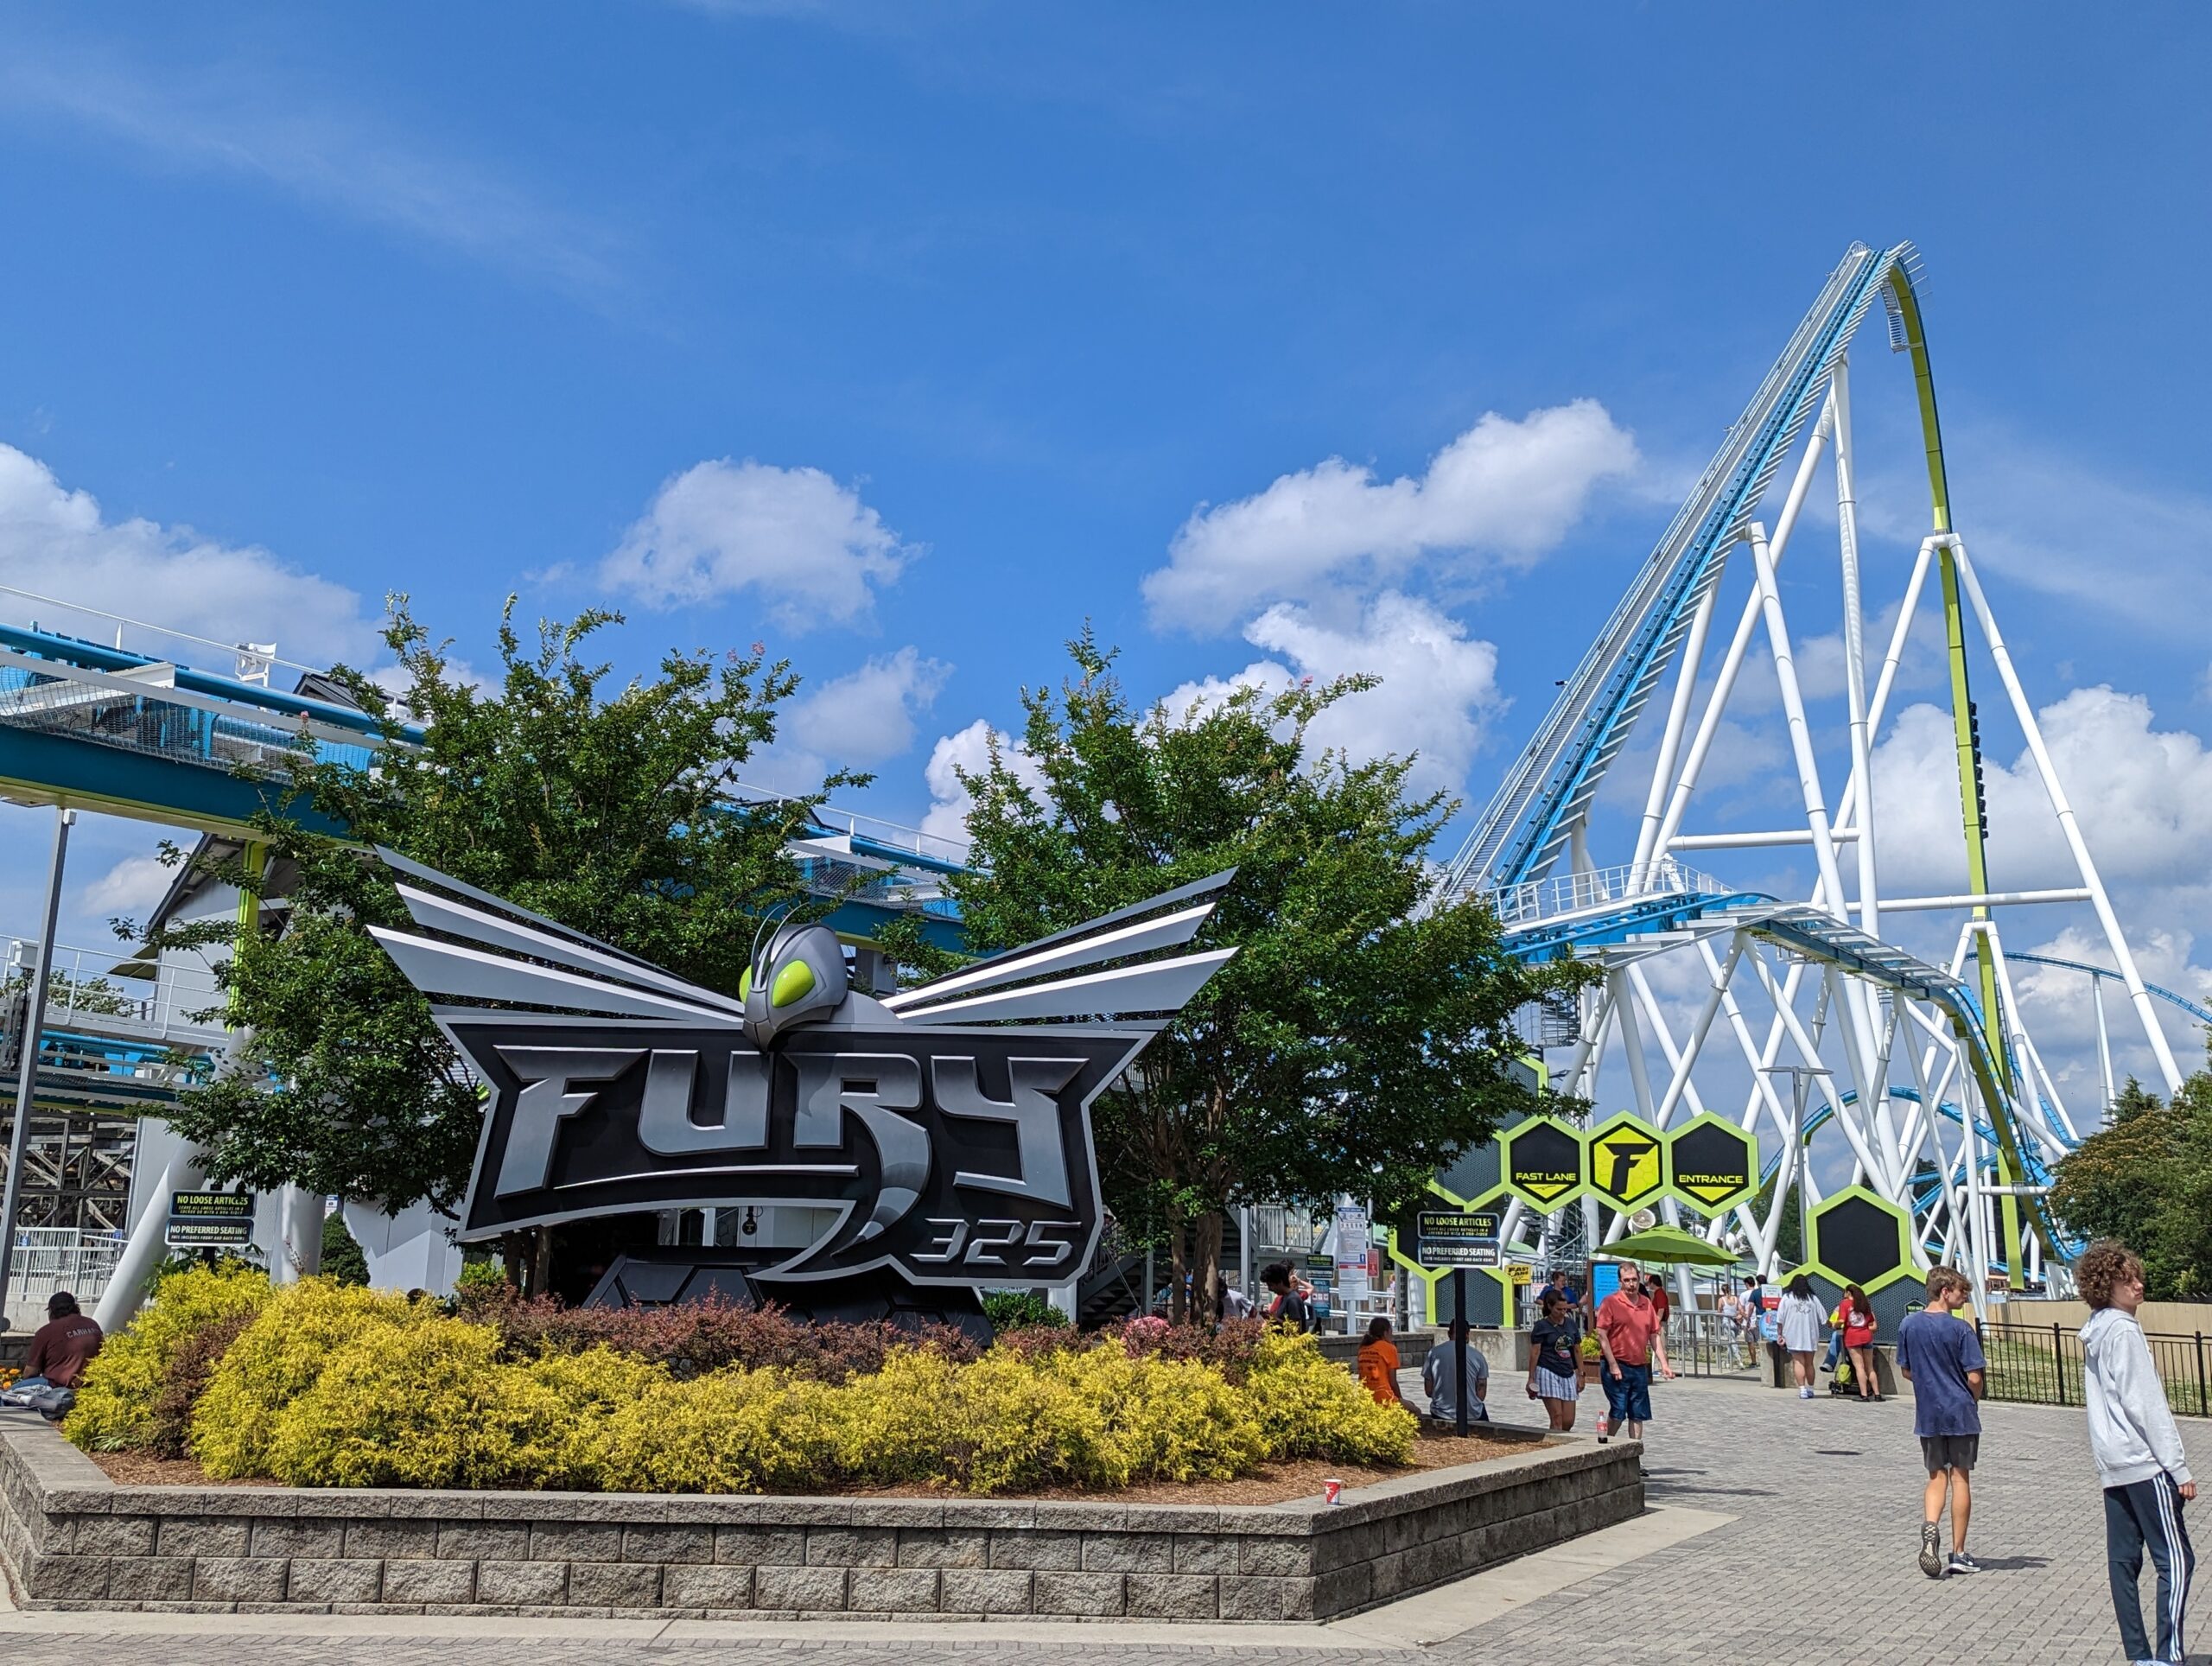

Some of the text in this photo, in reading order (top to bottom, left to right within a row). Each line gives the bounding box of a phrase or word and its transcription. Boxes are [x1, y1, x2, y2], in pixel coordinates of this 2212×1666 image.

[493, 1044, 1090, 1255] FURY
[1545, 1173, 1576, 1181] LANE
[1679, 1175, 1743, 1184] ENTRANCE
[177, 1195, 189, 1204] NO
[190, 1196, 213, 1205] LOOSE
[1424, 1217, 1492, 1226] NO LOOSE ARTICLES
[181, 1225, 219, 1234] PREFERRED
[219, 1226, 247, 1235] SEATING
[909, 1218, 1081, 1266] 325
[1432, 1247, 1468, 1256] PREFERRED
[1469, 1248, 1496, 1256] SEATING
